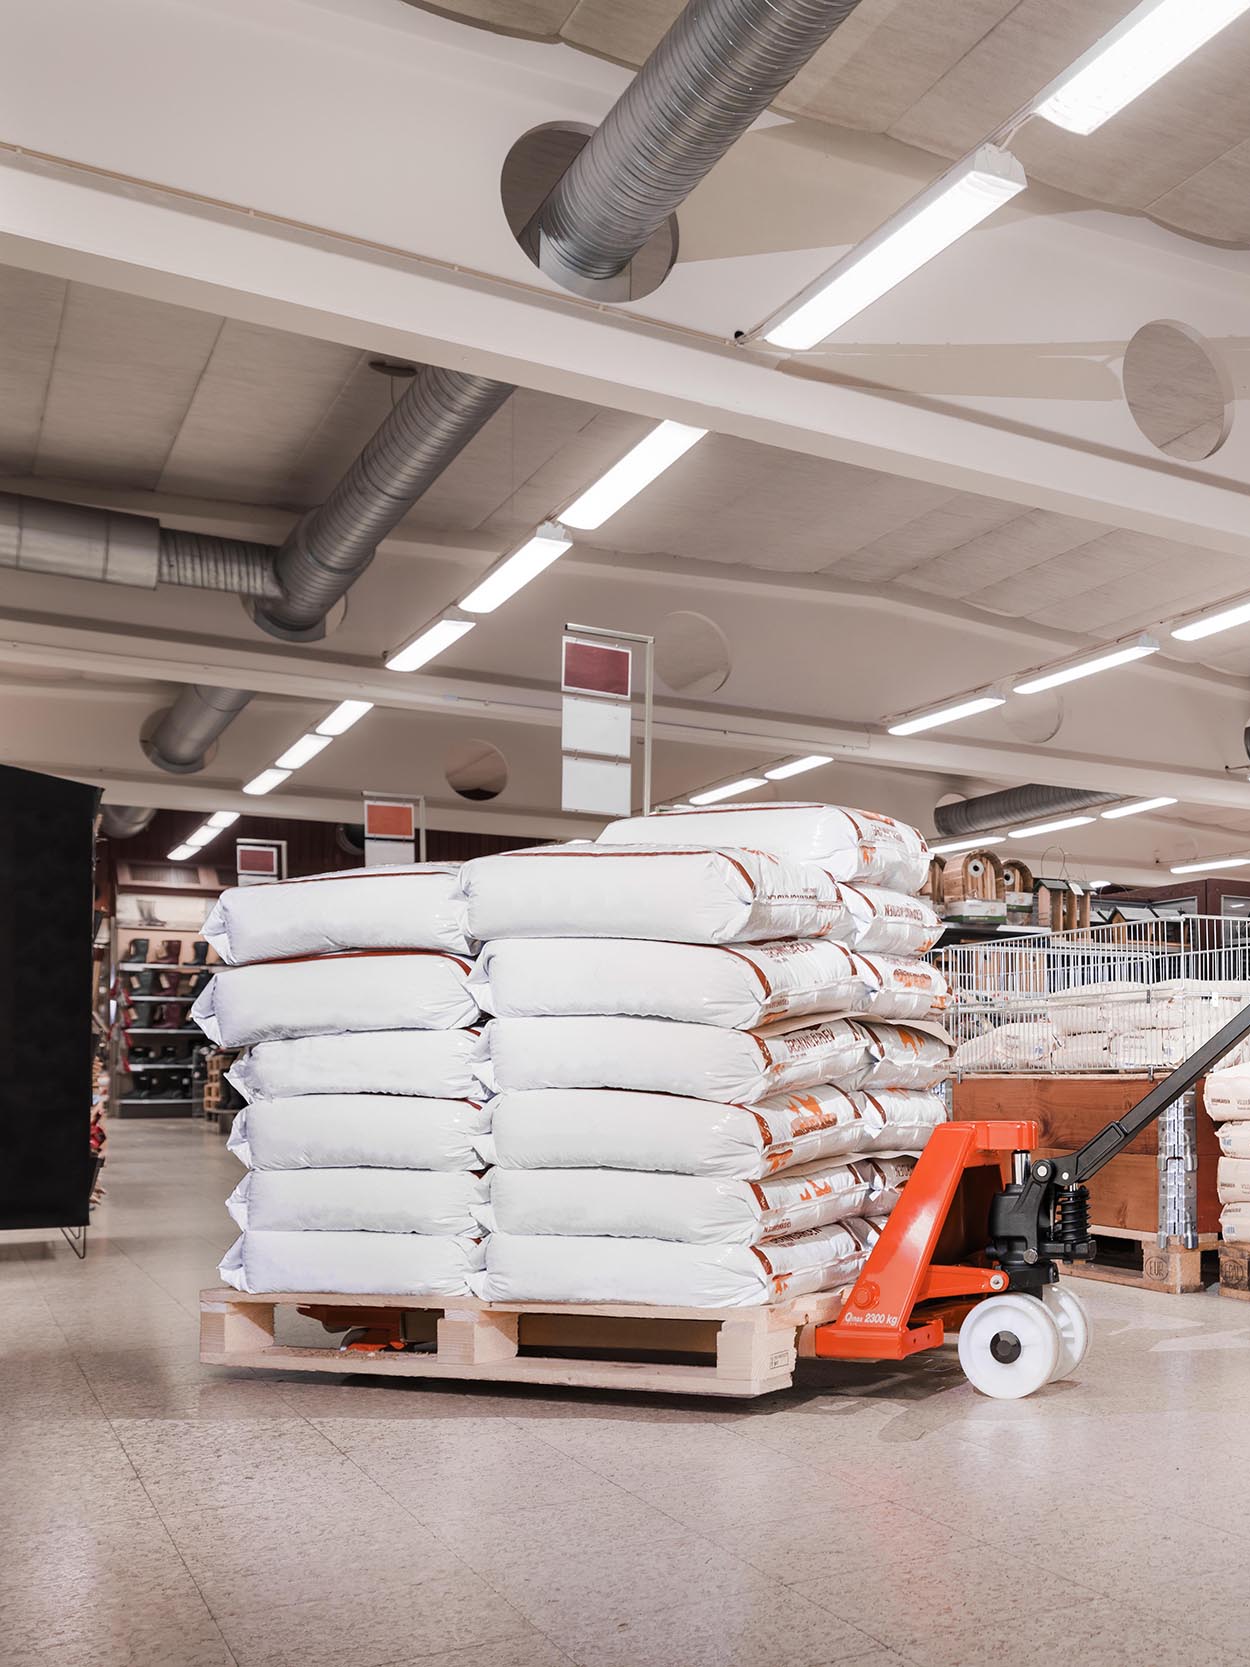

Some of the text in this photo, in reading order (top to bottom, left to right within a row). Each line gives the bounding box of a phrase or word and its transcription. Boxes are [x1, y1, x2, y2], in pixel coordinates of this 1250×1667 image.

[1149, 1260, 1164, 1277] EUR
[864, 1313, 886, 1325] 2300
[886, 1315, 899, 1327] kg
